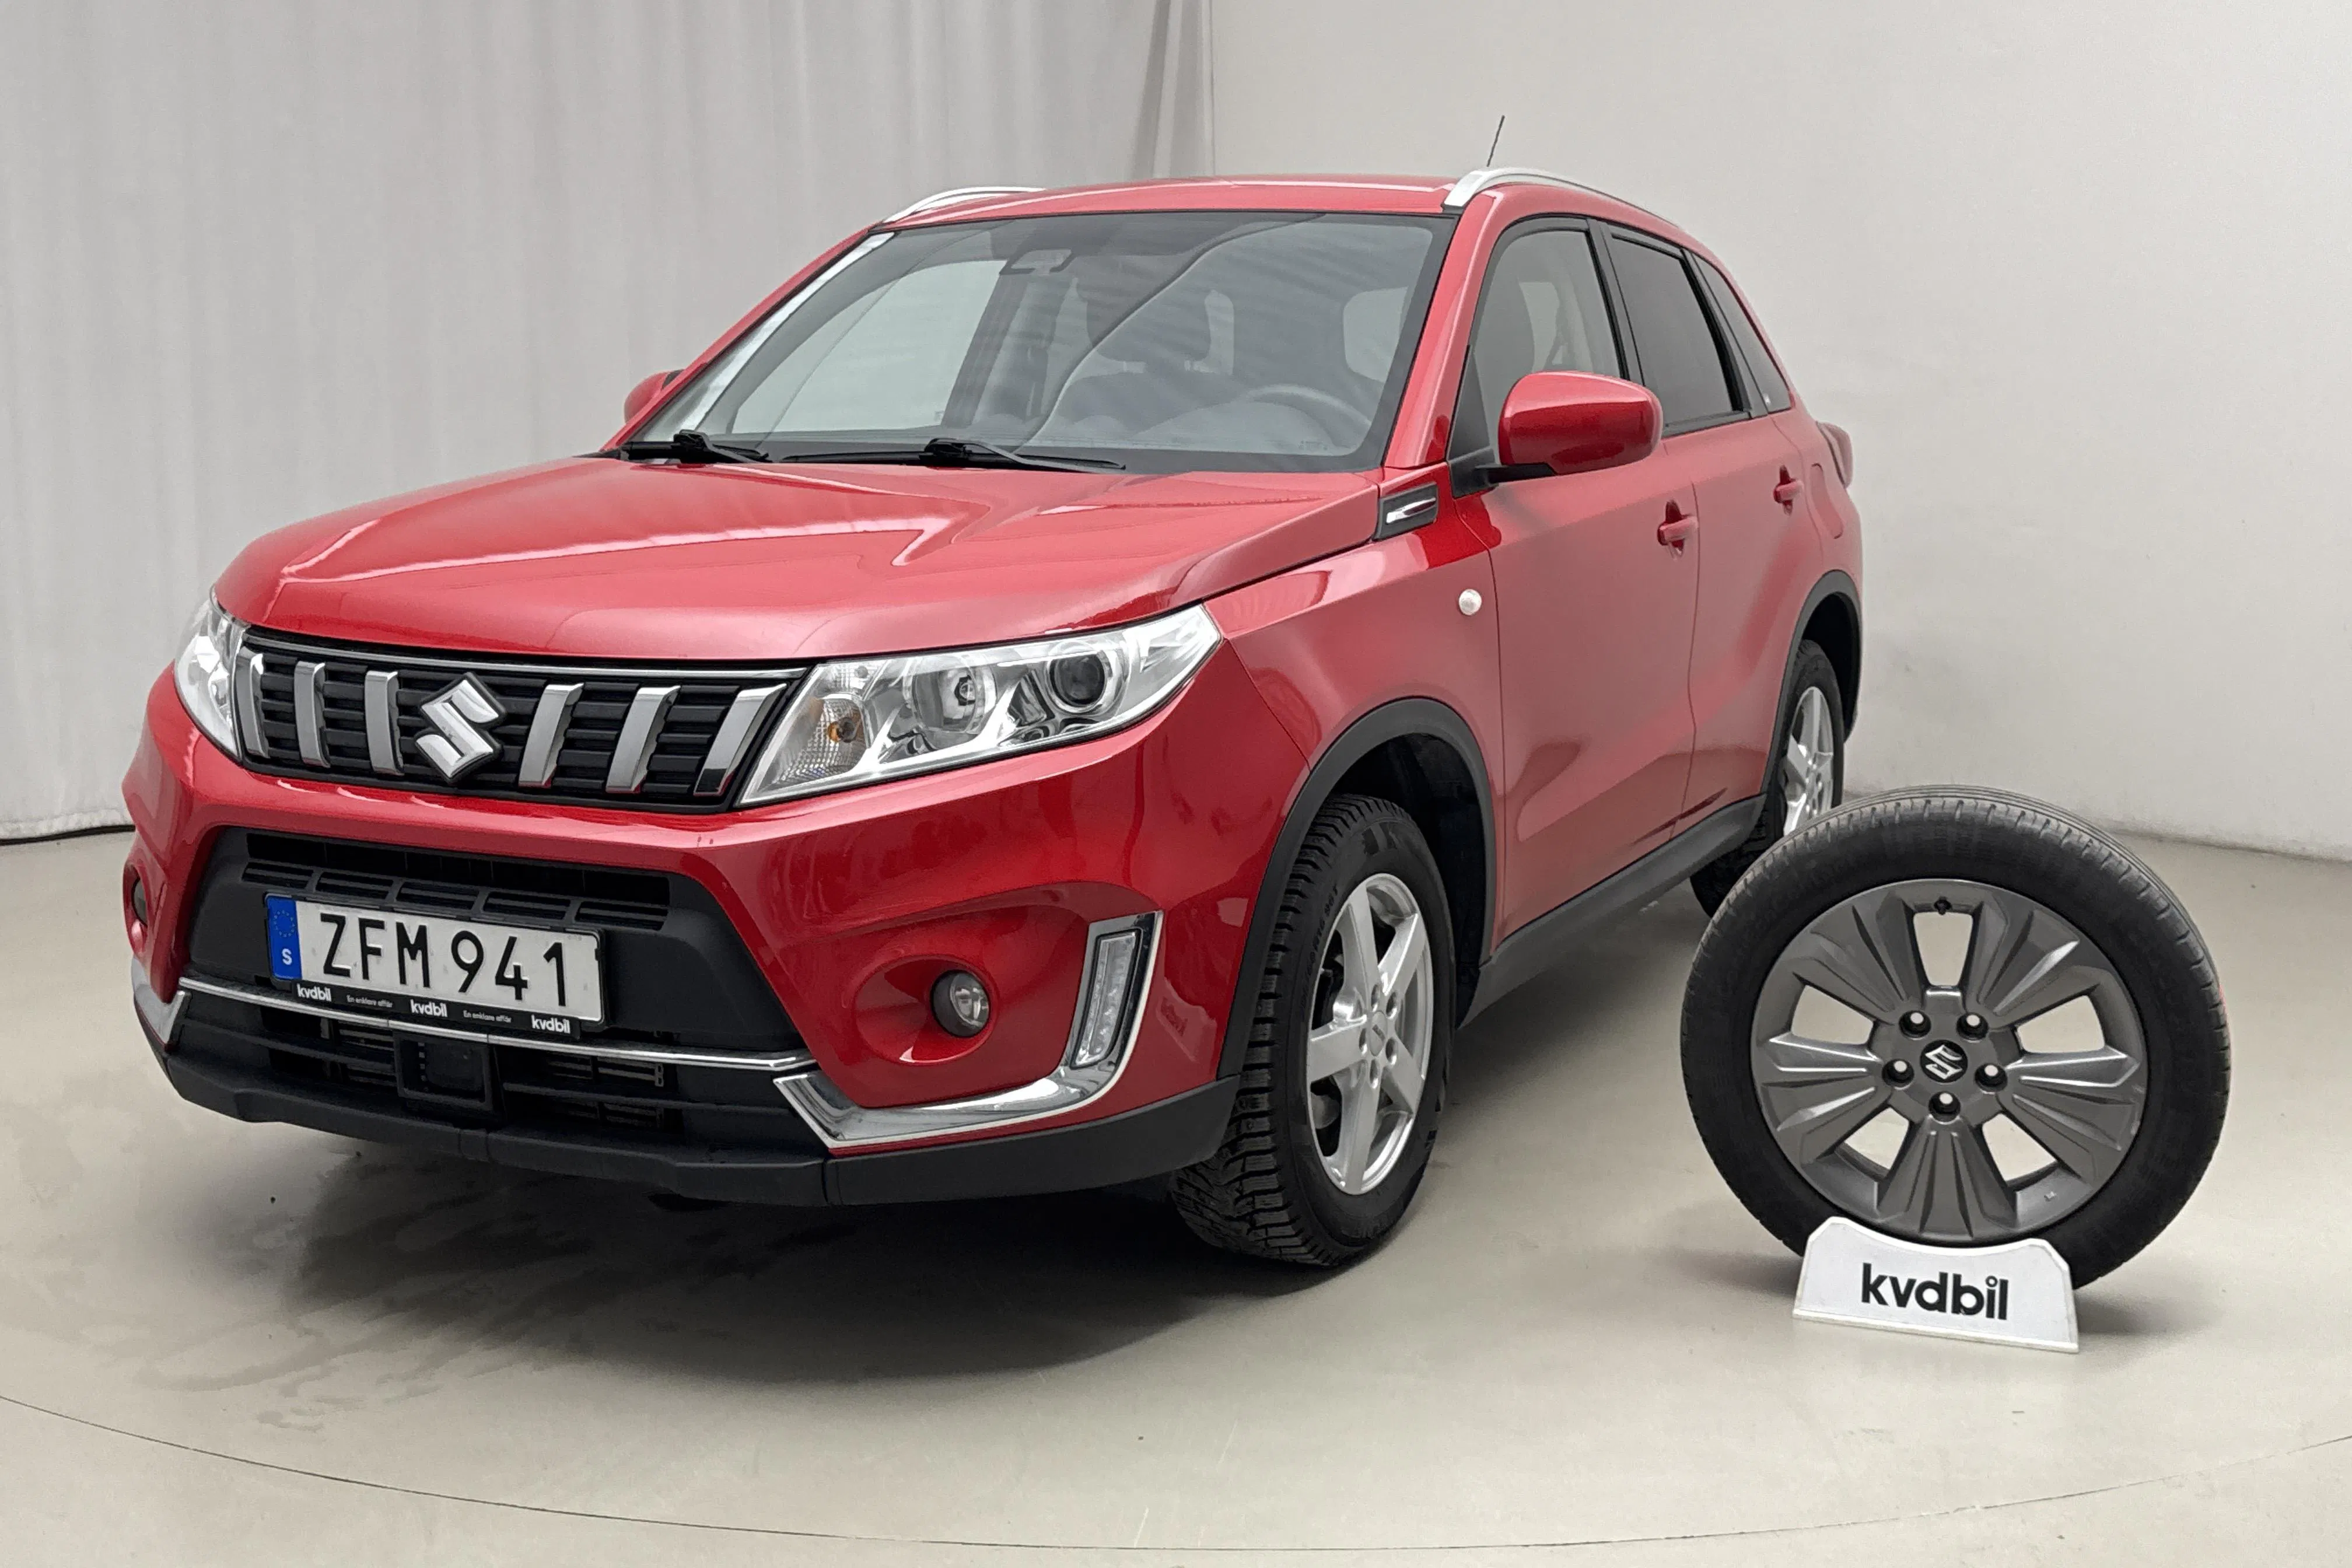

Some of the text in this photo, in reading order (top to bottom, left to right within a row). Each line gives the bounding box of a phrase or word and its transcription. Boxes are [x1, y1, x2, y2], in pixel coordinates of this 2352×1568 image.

[281, 948, 292, 965] S
[320, 912, 566, 1007] ZFM 941
[296, 983, 332, 1002] kvdbil
[410, 998, 448, 1018] kvdbil
[531, 1014, 571, 1034] kvdbil
[1861, 1262, 2010, 1321] kvdbil
